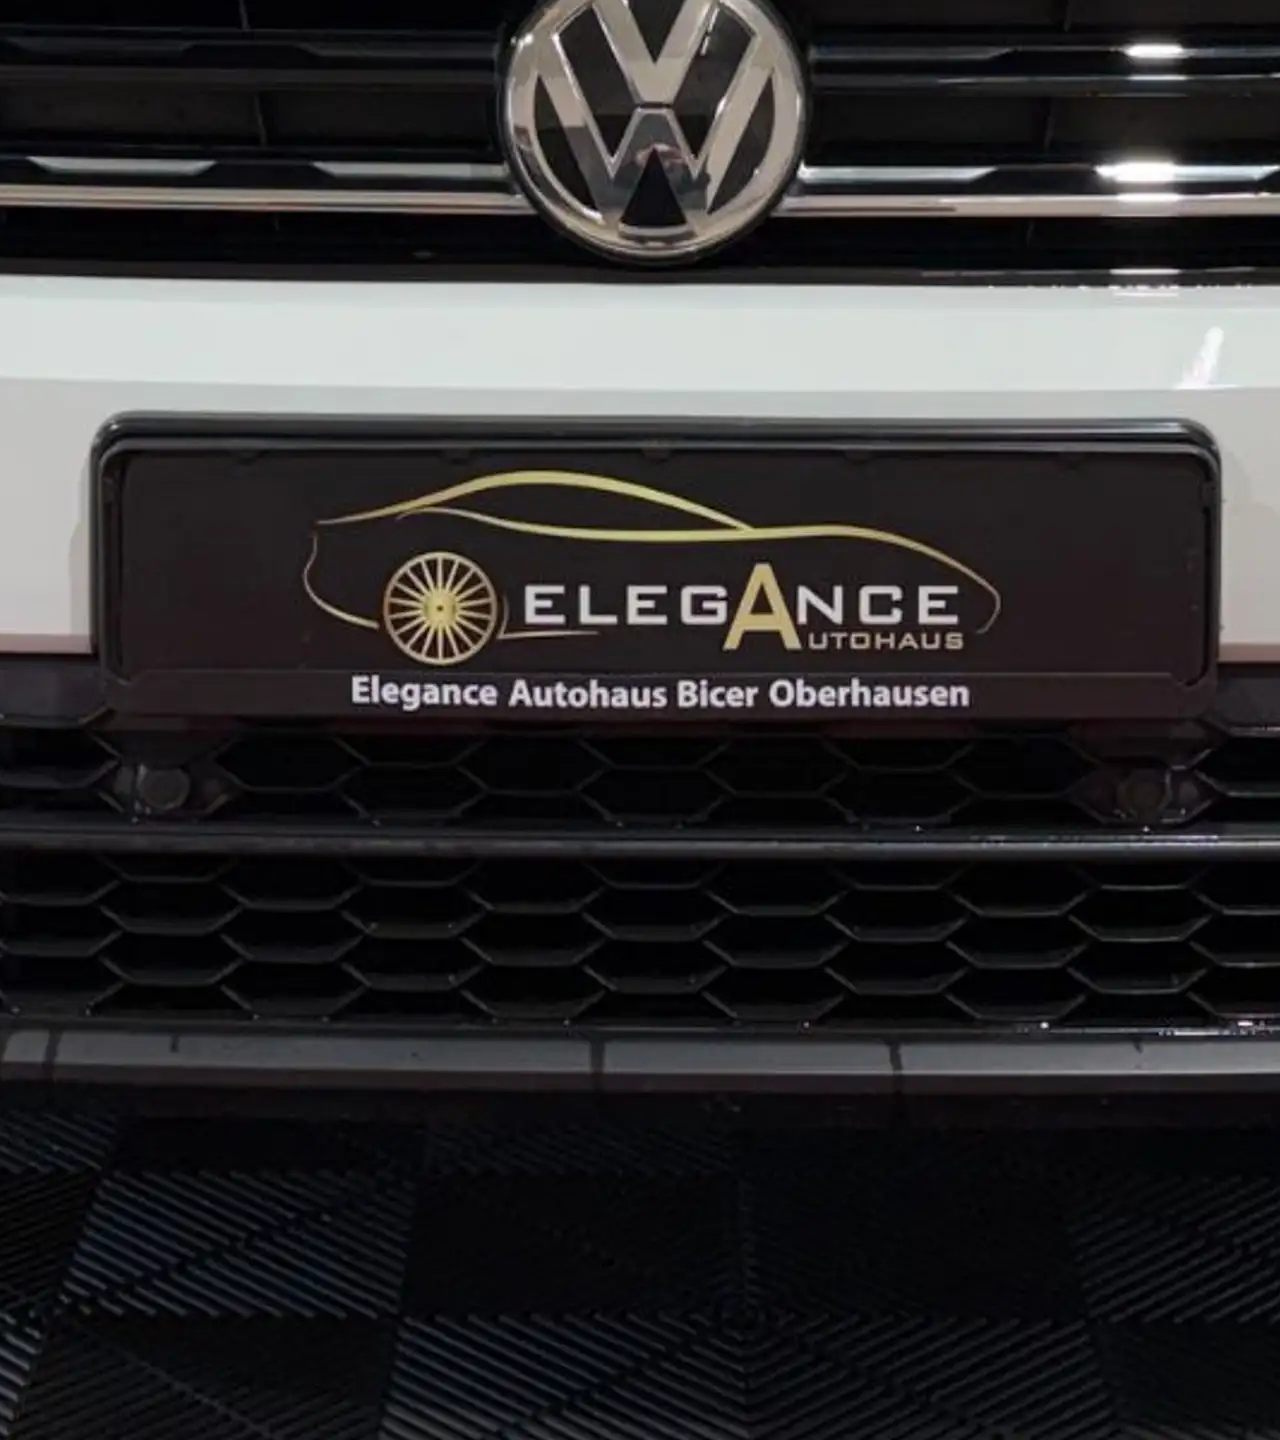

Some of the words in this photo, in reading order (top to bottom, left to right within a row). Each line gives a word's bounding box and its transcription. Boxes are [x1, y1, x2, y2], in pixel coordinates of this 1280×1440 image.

[524, 562, 959, 651] ELEGANCE
[350, 675, 498, 710] Elegance
[508, 679, 667, 709] Autohaus
[676, 679, 759, 709] Bicer
[769, 677, 971, 708] Oberhausen
